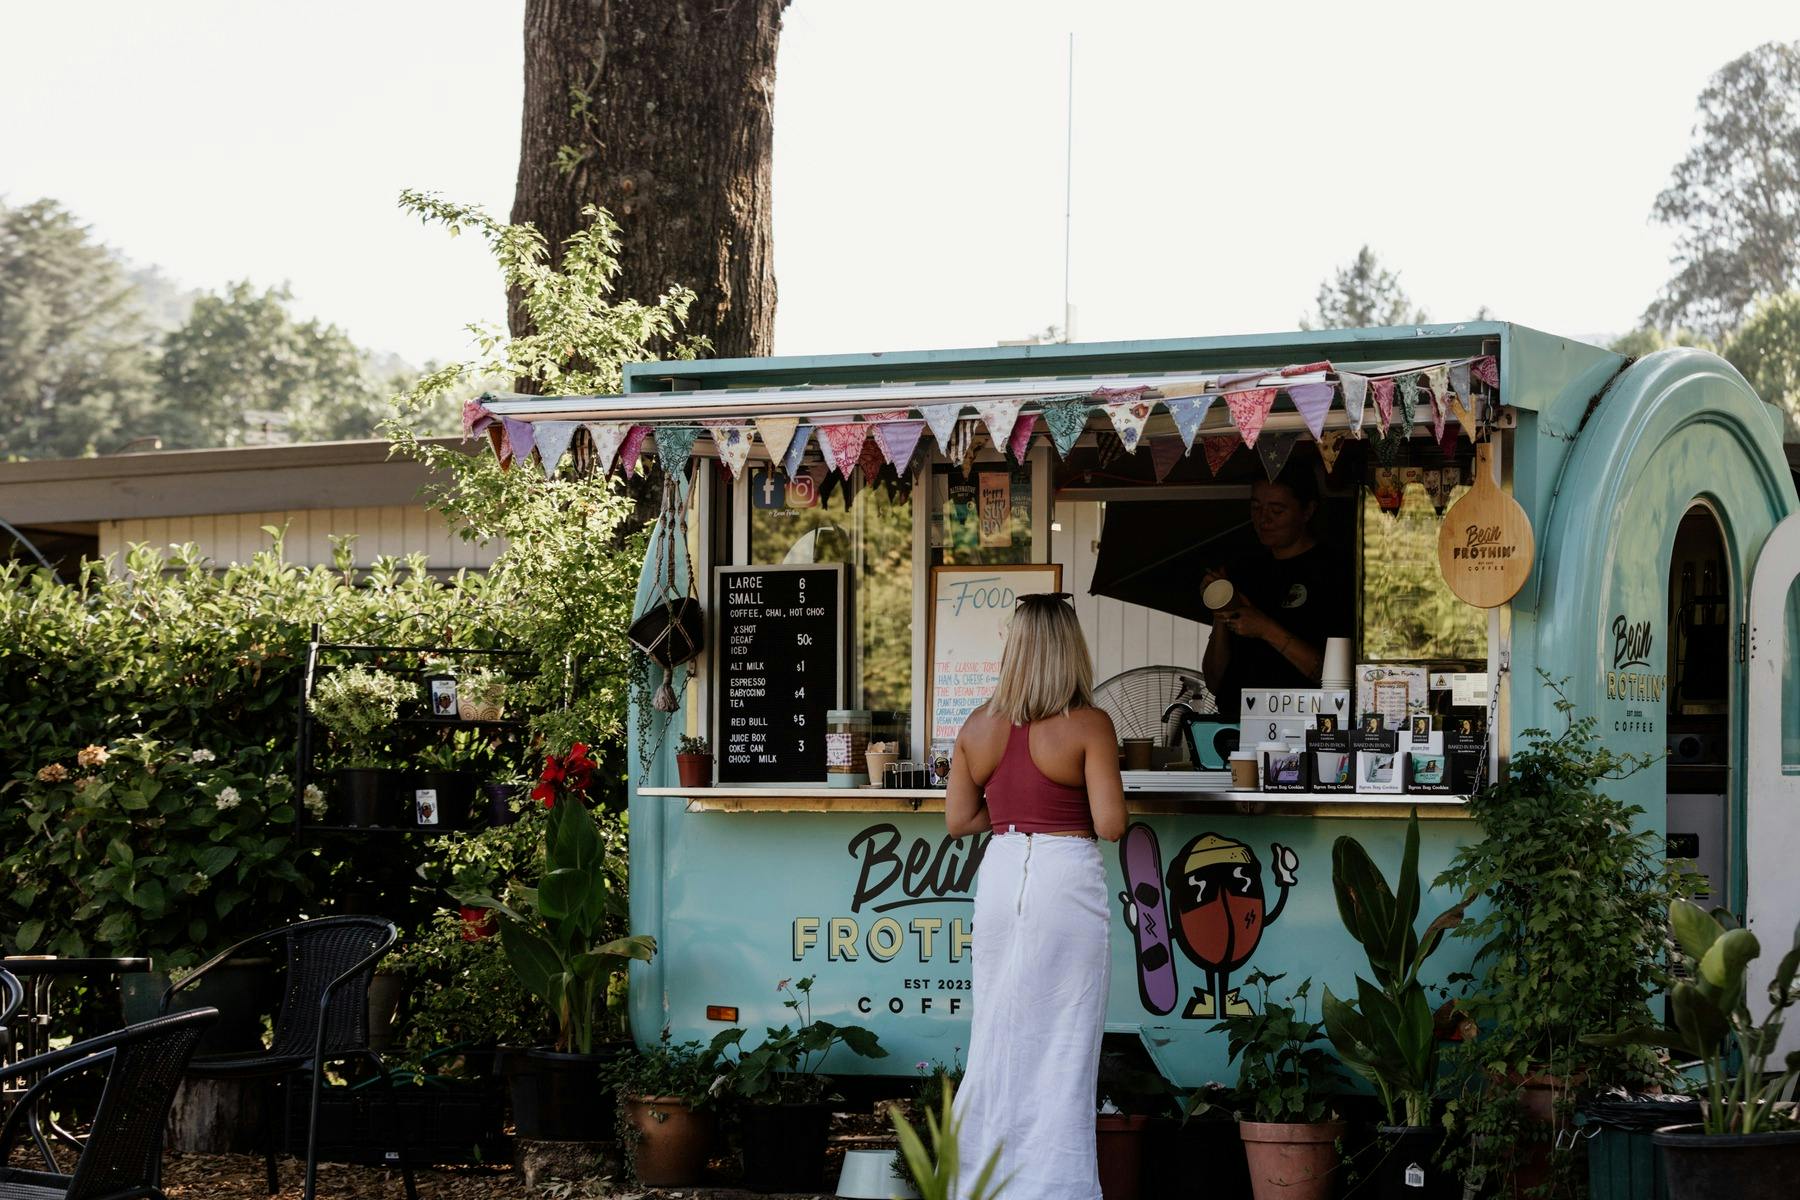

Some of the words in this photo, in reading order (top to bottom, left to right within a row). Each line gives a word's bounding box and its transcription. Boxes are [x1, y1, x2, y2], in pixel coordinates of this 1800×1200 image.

[1466, 525, 1502, 547] Bean
[729, 576, 763, 589] LARGE
[799, 577, 806, 589] 6
[729, 592, 764, 605] SMALL
[799, 591, 806, 604] 5
[950, 577, 1015, 616] FOOD
[789, 607, 803, 617] HOT
[806, 607, 825, 616] CHOC
[730, 635, 754, 644] DECAF
[1612, 615, 1652, 669] Bean
[730, 646, 748, 655] ICED
[730, 662, 743, 671] ALT
[746, 662, 765, 671] MILK
[796, 660, 805, 672] $1
[730, 677, 766, 687] ESPRESSO
[729, 688, 766, 697] BABYCCINO
[794, 686, 806, 699] $4
[730, 699, 745, 708] TEA
[1268, 695, 1321, 713] OPEN
[731, 717, 746, 726] RED
[748, 717, 769, 726] BULL
[1615, 721, 1653, 732] COFFEE
[1268, 722, 1277, 740] 8
[729, 733, 750, 742] JUICE
[751, 733, 767, 742] BOX
[728, 744, 746, 753] COKE
[749, 744, 764, 753] CAN
[798, 740, 805, 752] 3
[758, 754, 777, 763] MILK
[904, 979, 930, 989] EST
[938, 980, 972, 990] 2023
[858, 997, 961, 1014] COFF
